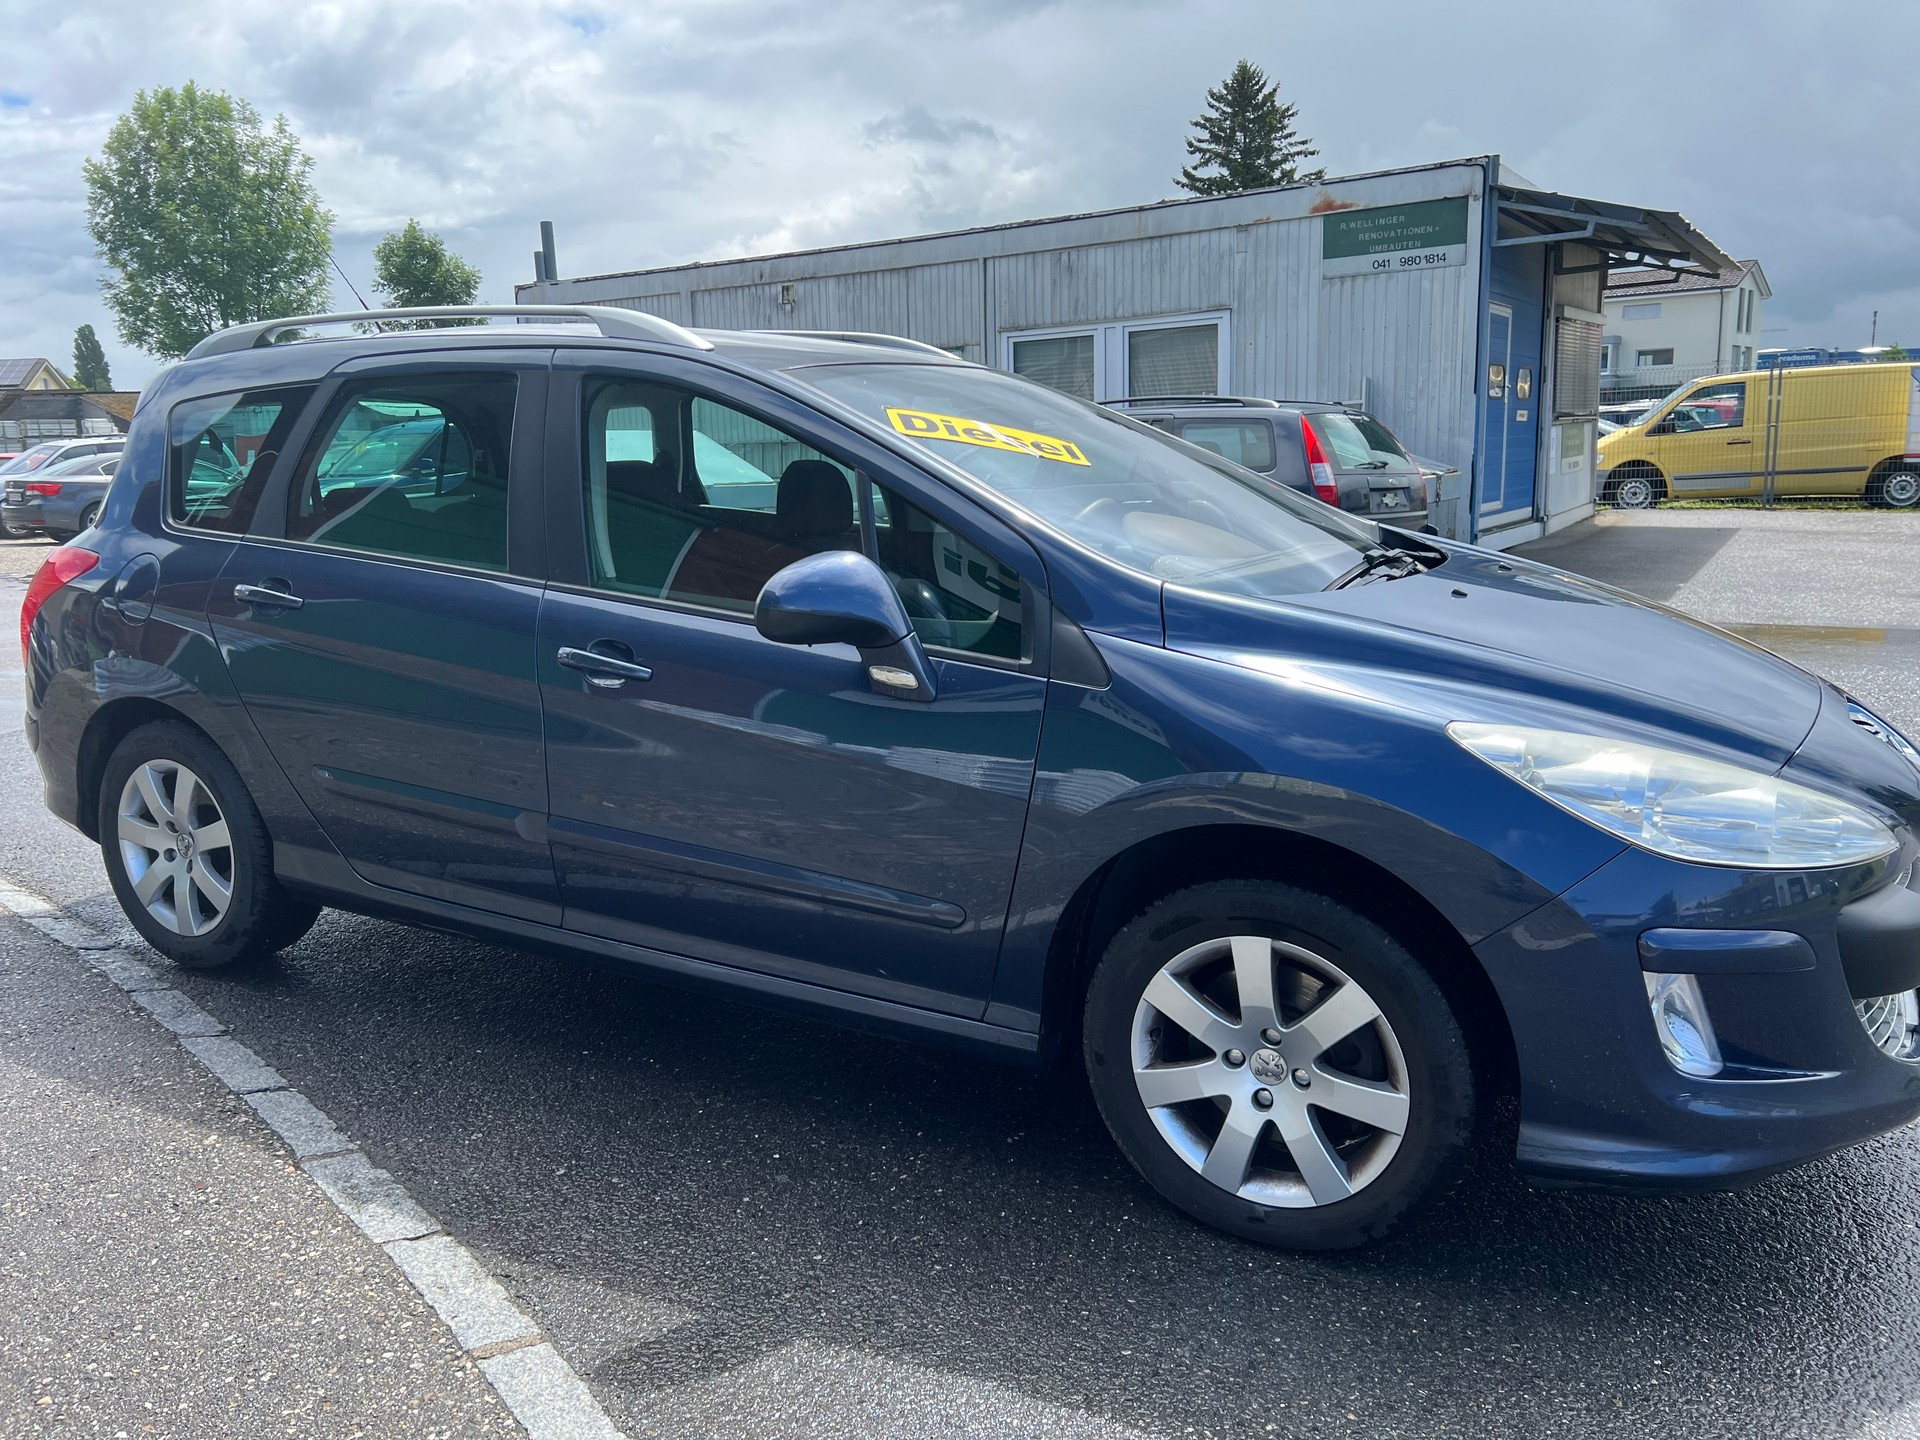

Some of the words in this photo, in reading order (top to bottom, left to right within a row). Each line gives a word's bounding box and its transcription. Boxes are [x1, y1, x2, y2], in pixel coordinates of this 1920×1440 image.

[1349, 215, 1405, 229] WELLINGER
[1369, 240, 1421, 253] UMBAUTEN
[1372, 258, 1391, 270] 041
[896, 412, 1082, 461] Diesel
